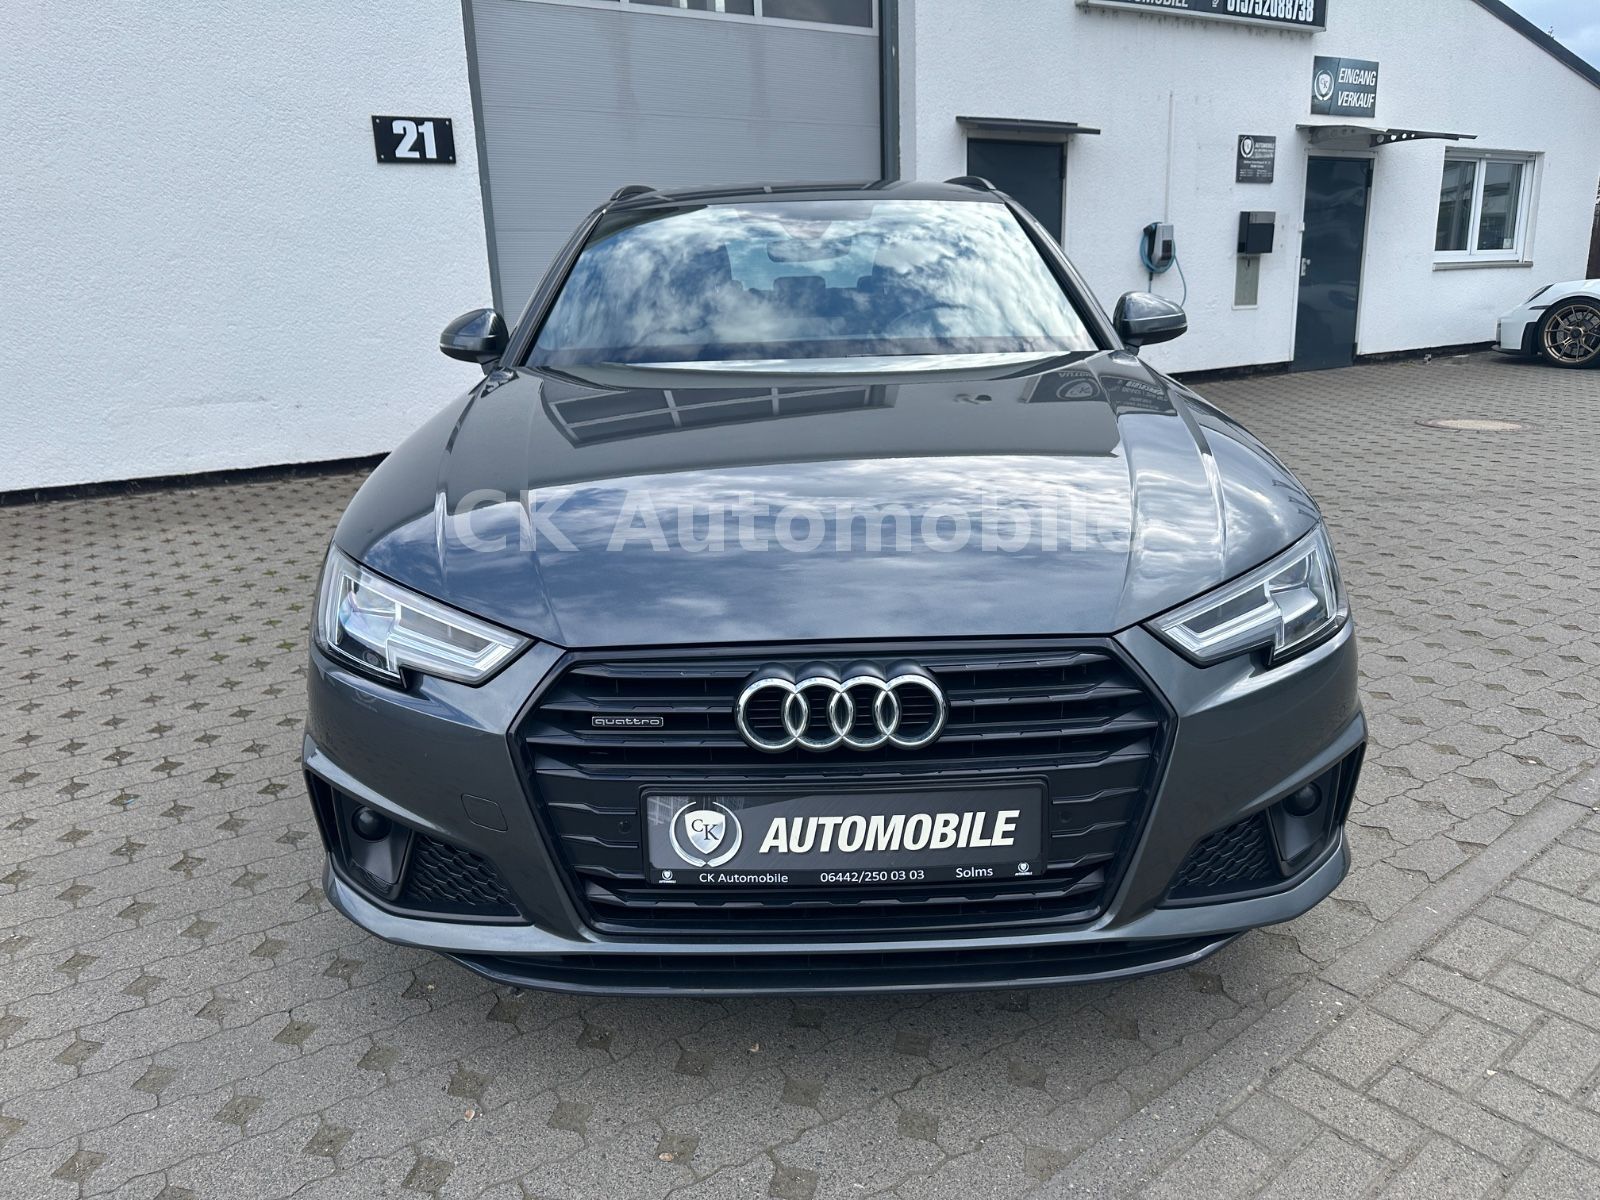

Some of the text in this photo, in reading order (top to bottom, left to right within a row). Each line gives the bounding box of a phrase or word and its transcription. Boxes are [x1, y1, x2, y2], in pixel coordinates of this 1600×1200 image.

[1338, 67, 1377, 86] EINGANG
[1337, 91, 1375, 108] VERKAUF
[392, 119, 438, 159] 21
[594, 718, 660, 726] quattro
[691, 818, 720, 841] CK
[758, 809, 1021, 854] AUTOMOBILE
[699, 866, 994, 883] CK Automobile 06442/250 03 03 Solms
